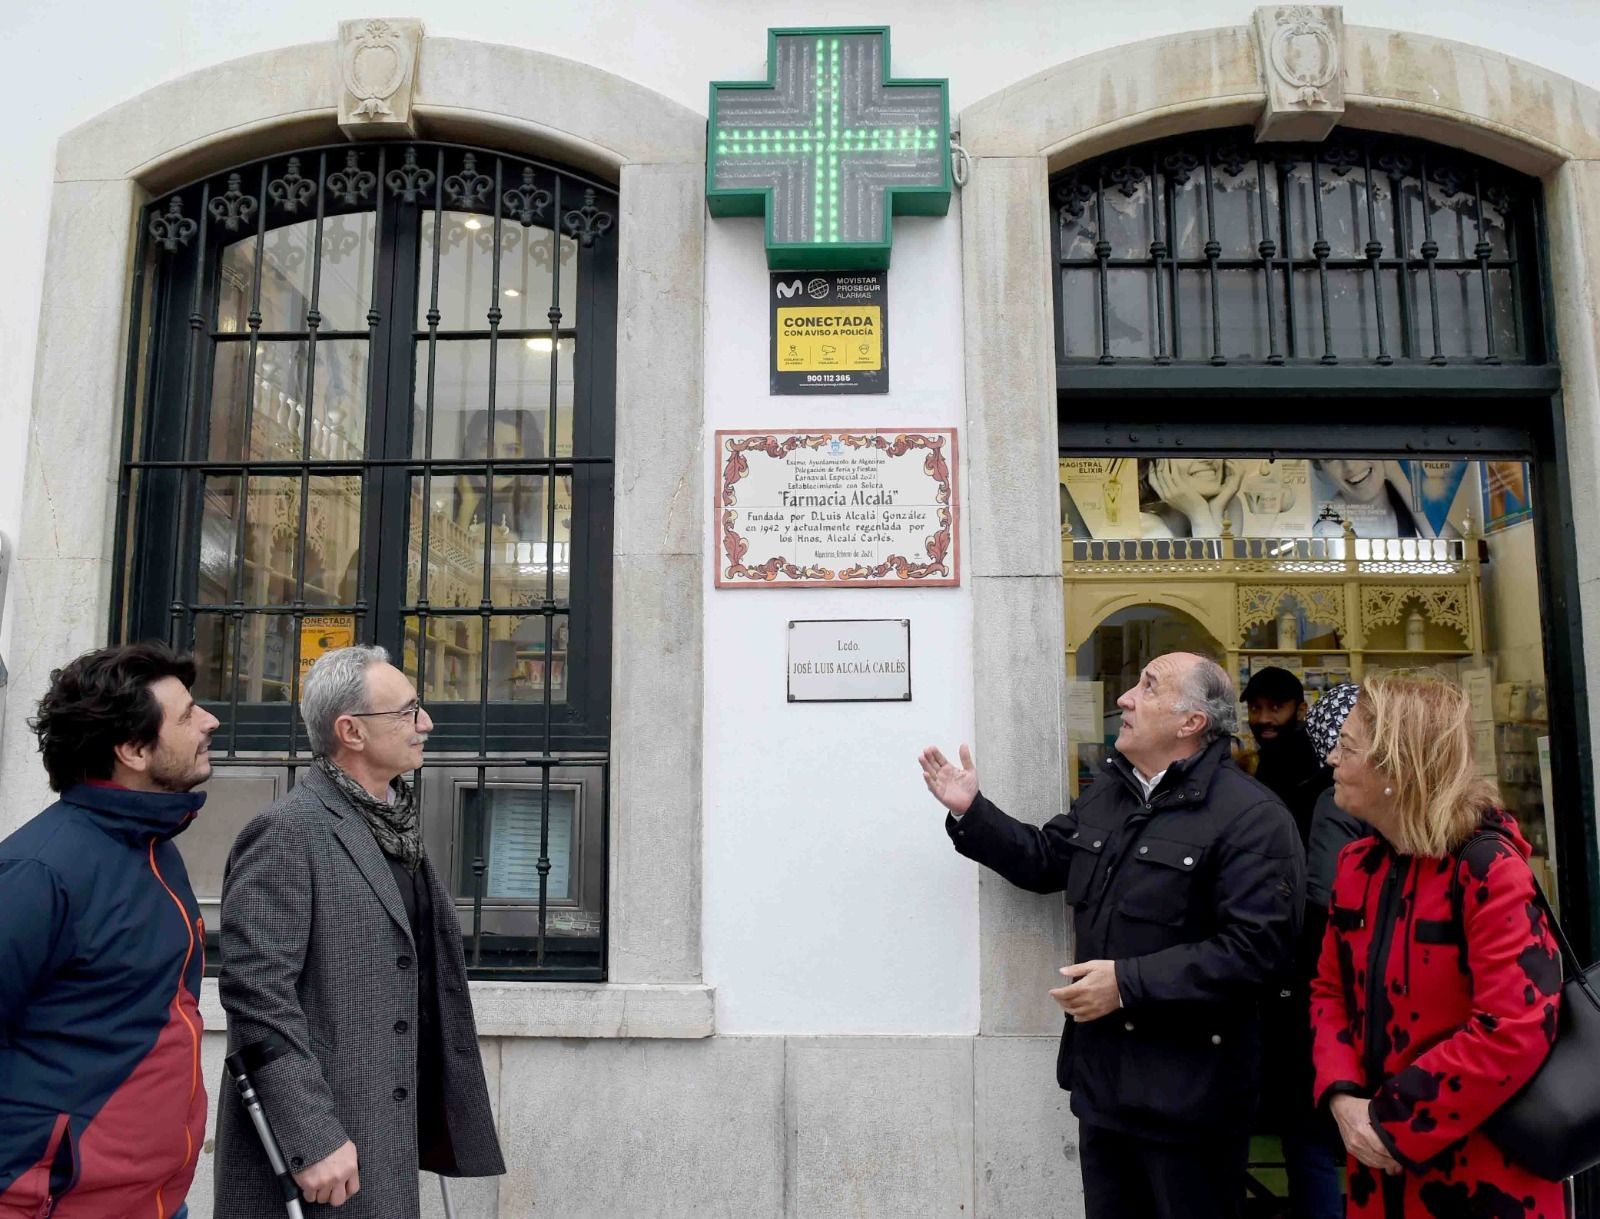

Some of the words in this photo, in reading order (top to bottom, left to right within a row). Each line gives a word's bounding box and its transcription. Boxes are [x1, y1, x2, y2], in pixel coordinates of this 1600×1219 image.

[836, 284, 881, 292] PROSEGUR
[784, 316, 873, 327] CONECTADA
[784, 329, 803, 337] CON
[840, 328, 873, 336] POLICÍA
[806, 374, 822, 382] 900
[823, 374, 835, 382] 112
[1059, 461, 1103, 469] MAGISTRAL
[1424, 462, 1450, 470] FILLER
[829, 473, 858, 482] Especial
[747, 511, 784, 521] Fundada
[790, 514, 805, 523] por
[845, 510, 876, 520] Alcalá
[882, 510, 926, 523] González
[760, 524, 780, 535] 1942
[785, 525, 791, 535] y
[793, 523, 851, 532] actualmente
[855, 522, 902, 533] regentada
[909, 523, 925, 533] por
[779, 534, 793, 543] los
[826, 533, 857, 542] Alcalá
[301, 617, 352, 625] ONECTADA
[837, 639, 860, 651] Lcdo.
[793, 660, 812, 674] JOSÉ
[814, 662, 834, 674] LUIS
[836, 660, 871, 674] ALCALÁ
[872, 660, 906, 673] CARLÉS
